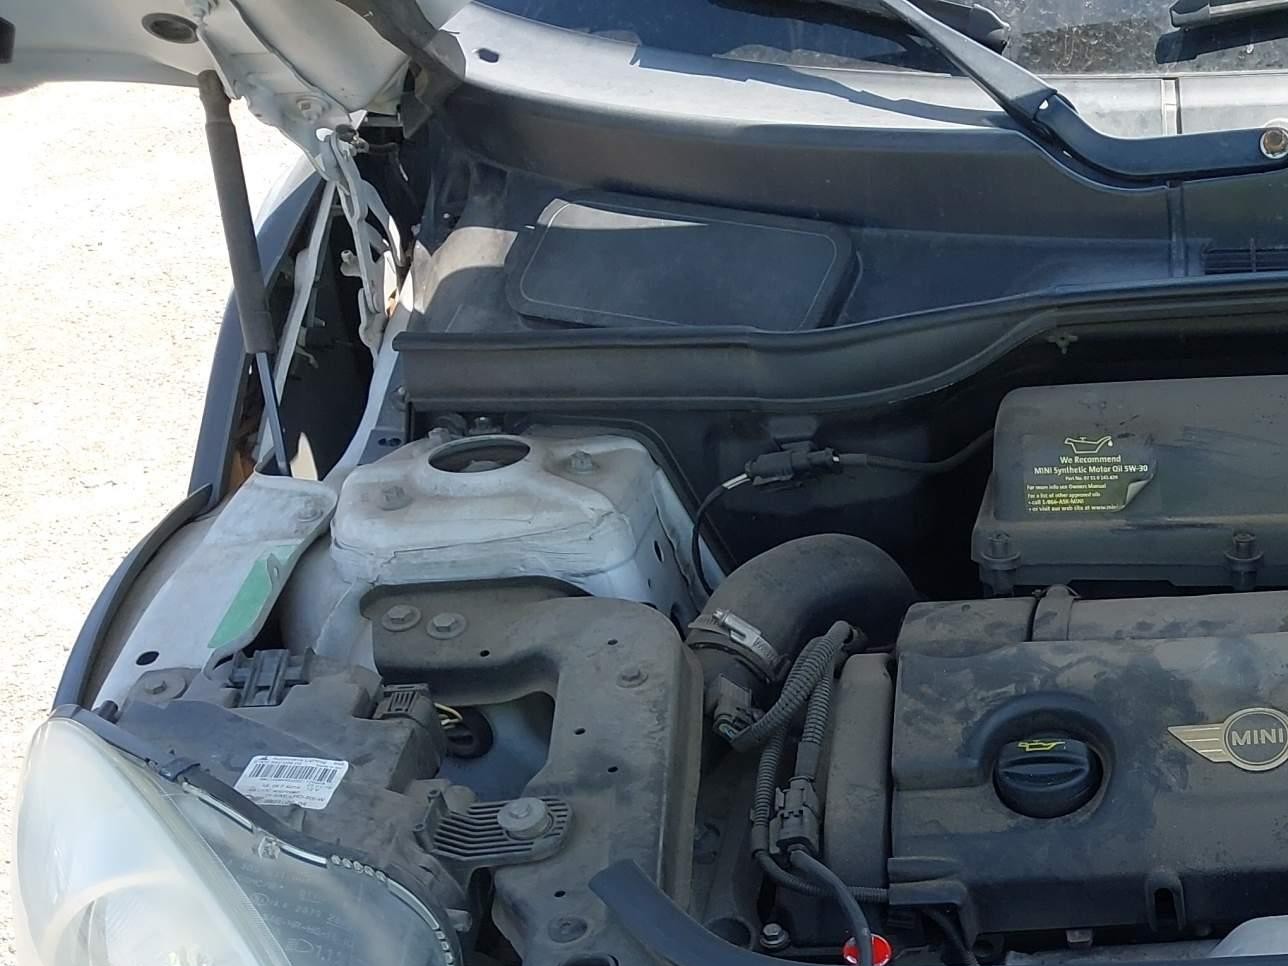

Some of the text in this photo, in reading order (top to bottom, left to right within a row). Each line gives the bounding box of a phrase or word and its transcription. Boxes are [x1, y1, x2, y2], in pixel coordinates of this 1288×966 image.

[1059, 455, 1121, 464] We Recommend
[1053, 465, 1087, 476] Synthetic
[1088, 465, 1111, 473] Motor
[1124, 464, 1148, 473] 5W-30
[1231, 727, 1284, 746] MINI
